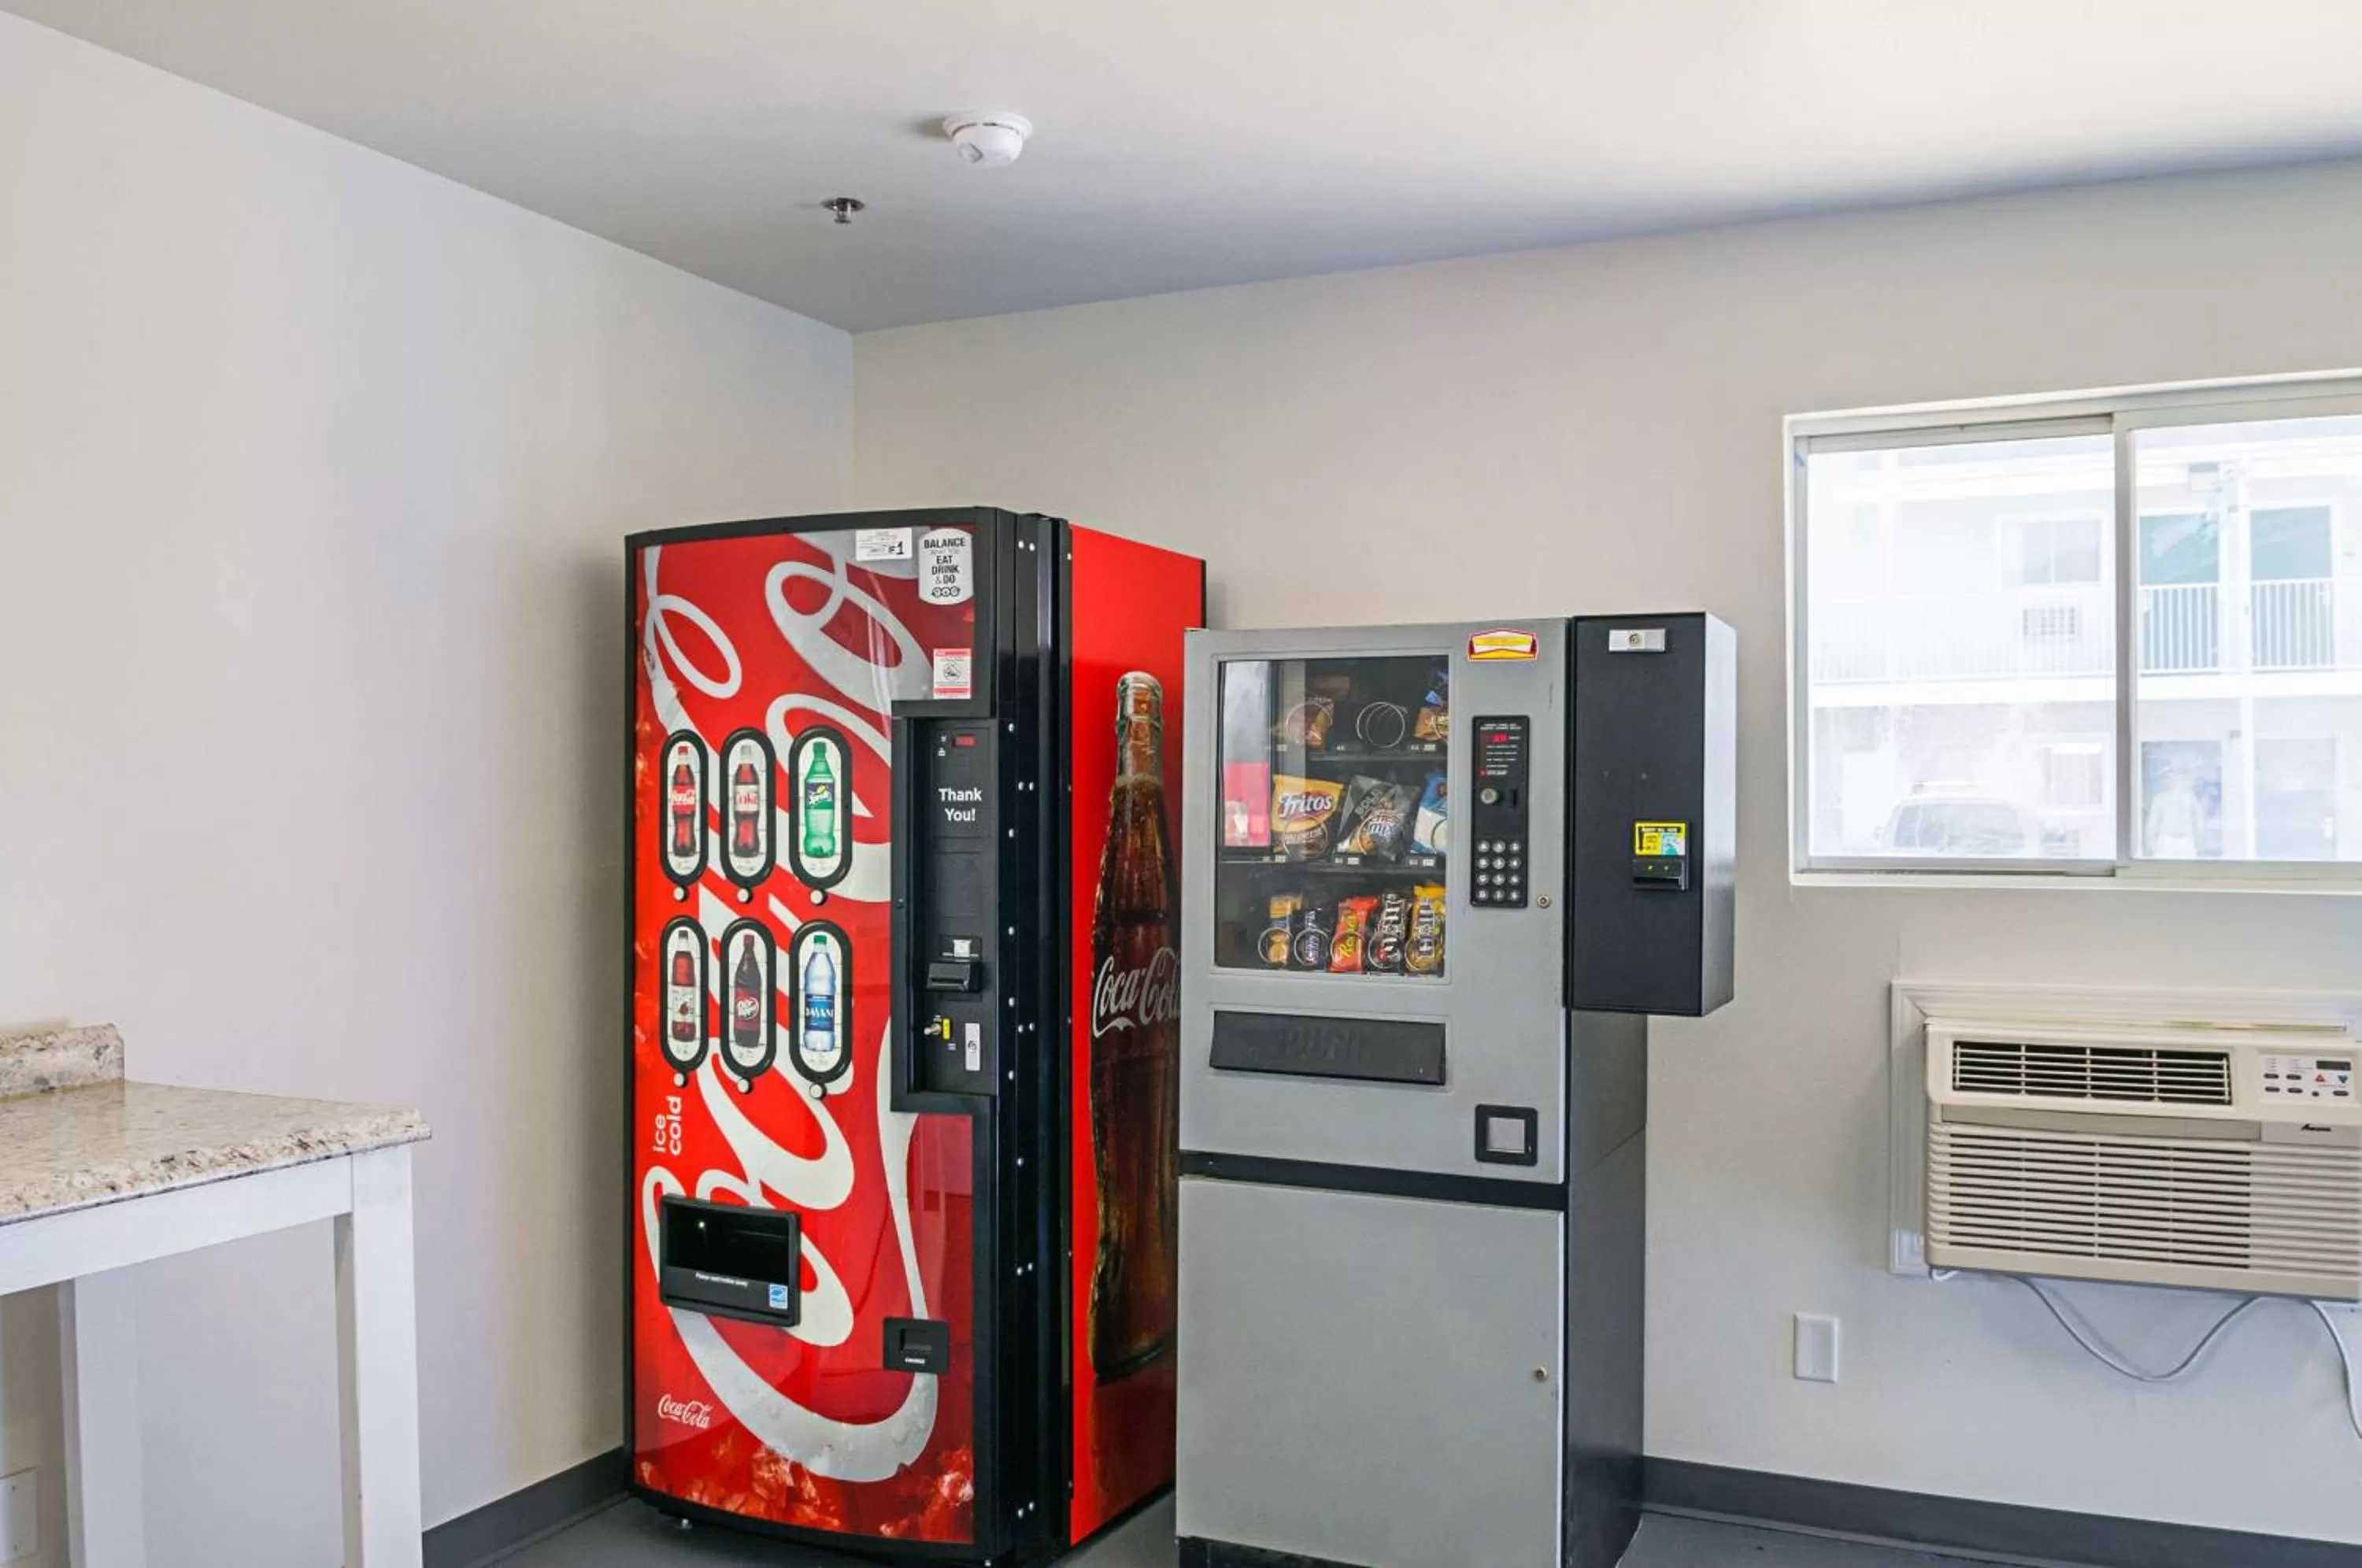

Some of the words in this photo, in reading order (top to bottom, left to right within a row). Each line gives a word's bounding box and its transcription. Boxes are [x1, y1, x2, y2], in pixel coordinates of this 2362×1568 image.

[924, 538, 966, 549] BALANCE
[936, 555, 953, 564] EAT
[931, 564, 960, 575] DRINK
[942, 575, 956, 584] DO
[938, 787, 983, 801] Thank
[1279, 790, 1334, 818] Fritos
[944, 808, 976, 822] You!
[665, 1095, 682, 1156] cold
[652, 1114, 667, 1152] ice
[657, 1393, 713, 1429] Coca-Cola
